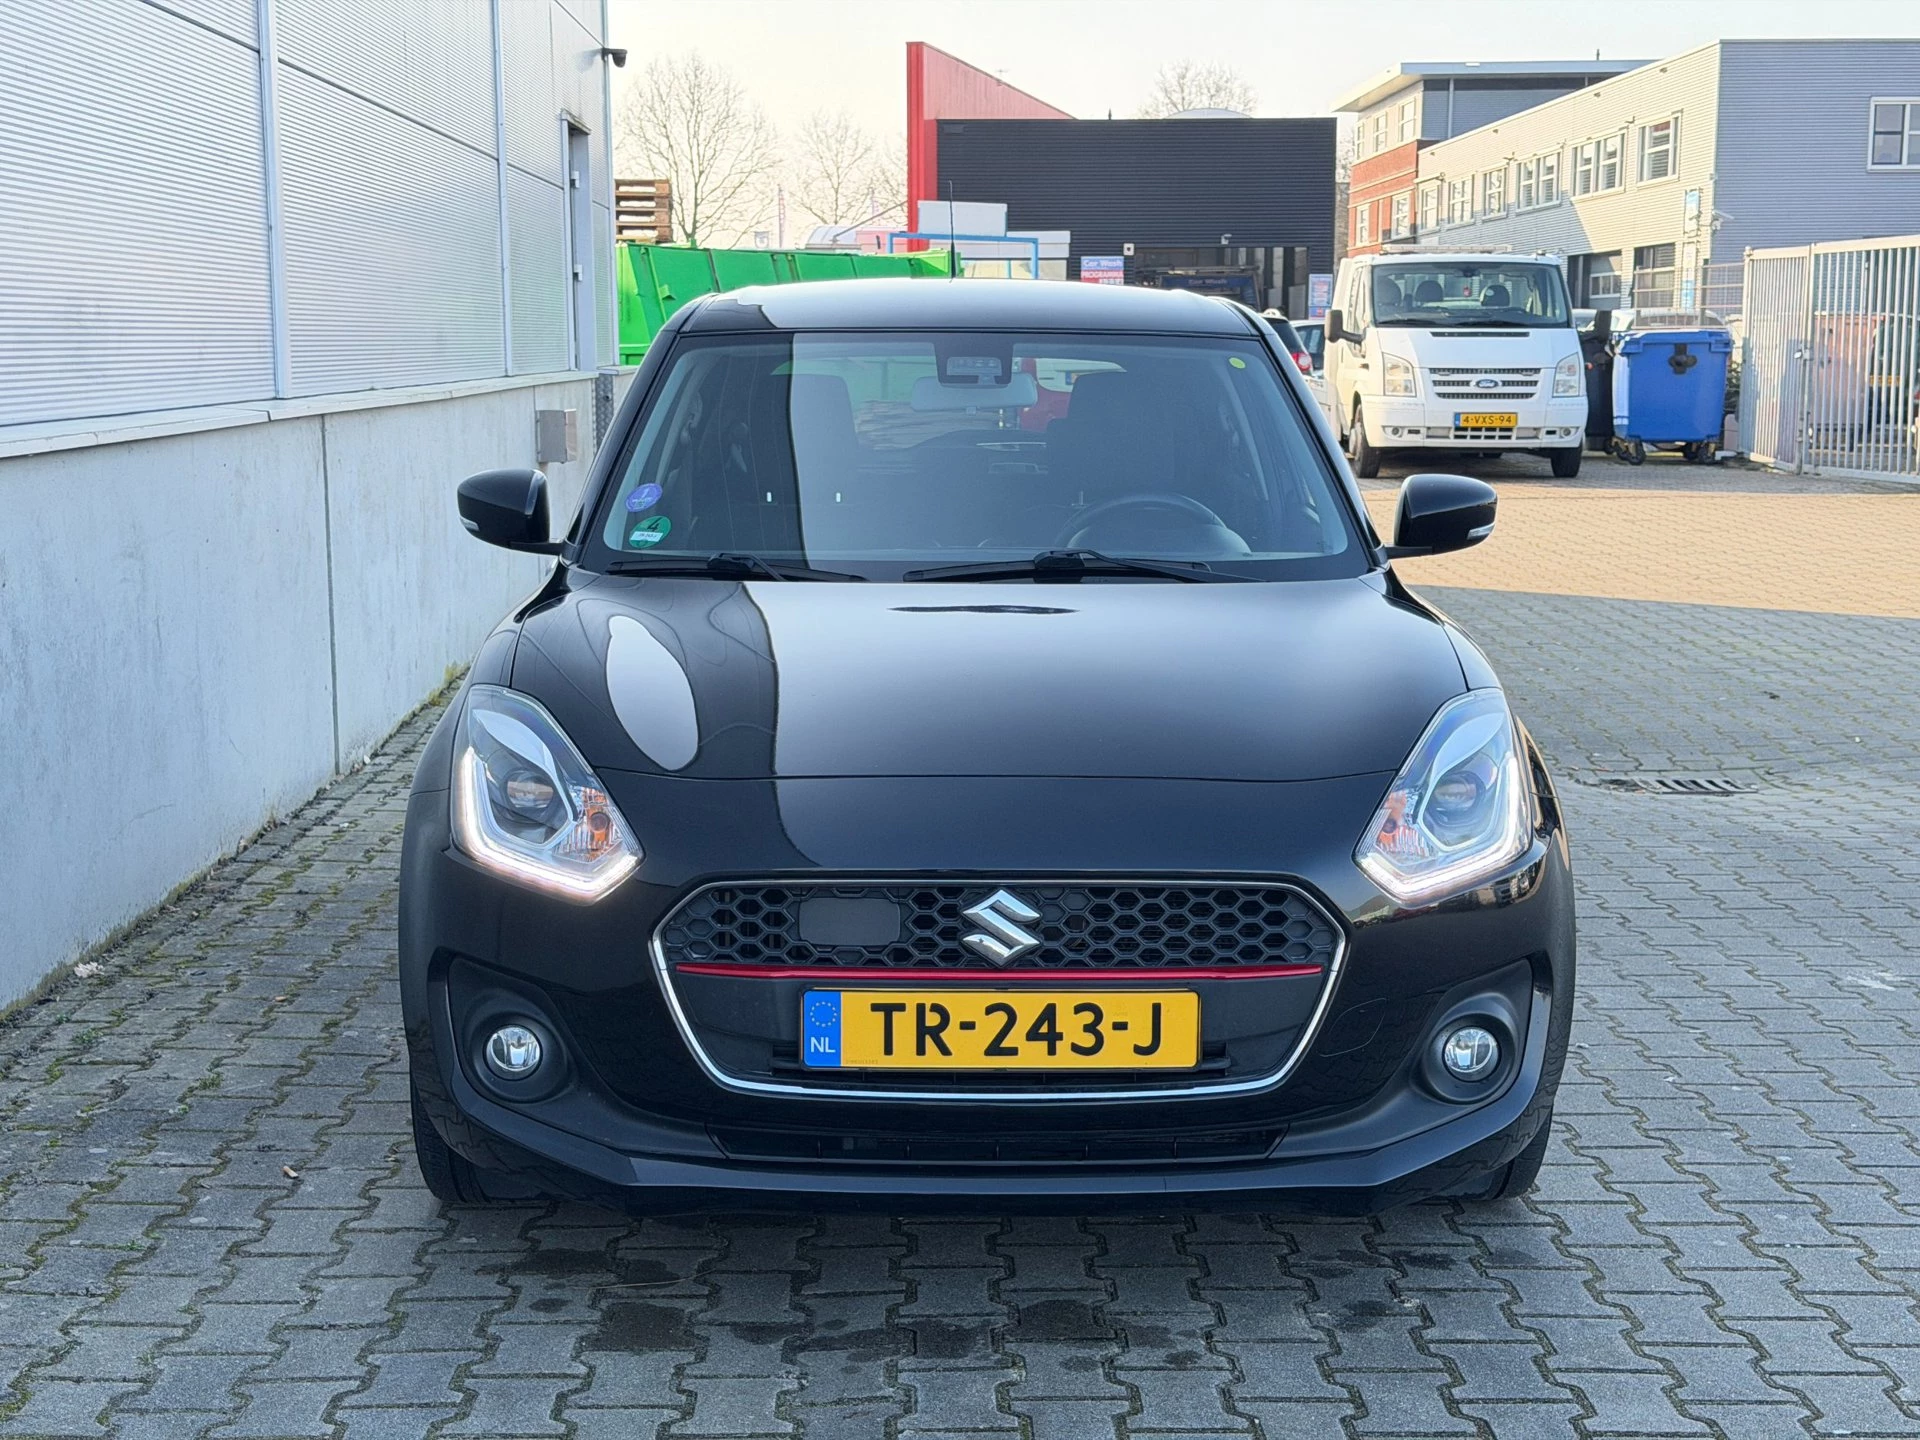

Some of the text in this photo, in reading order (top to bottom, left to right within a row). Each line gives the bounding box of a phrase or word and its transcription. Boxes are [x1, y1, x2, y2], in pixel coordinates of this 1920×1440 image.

[1463, 415, 1512, 425] 4-VXS-94
[870, 1002, 1162, 1057] TR-243-J
[810, 1036, 836, 1054] NL
